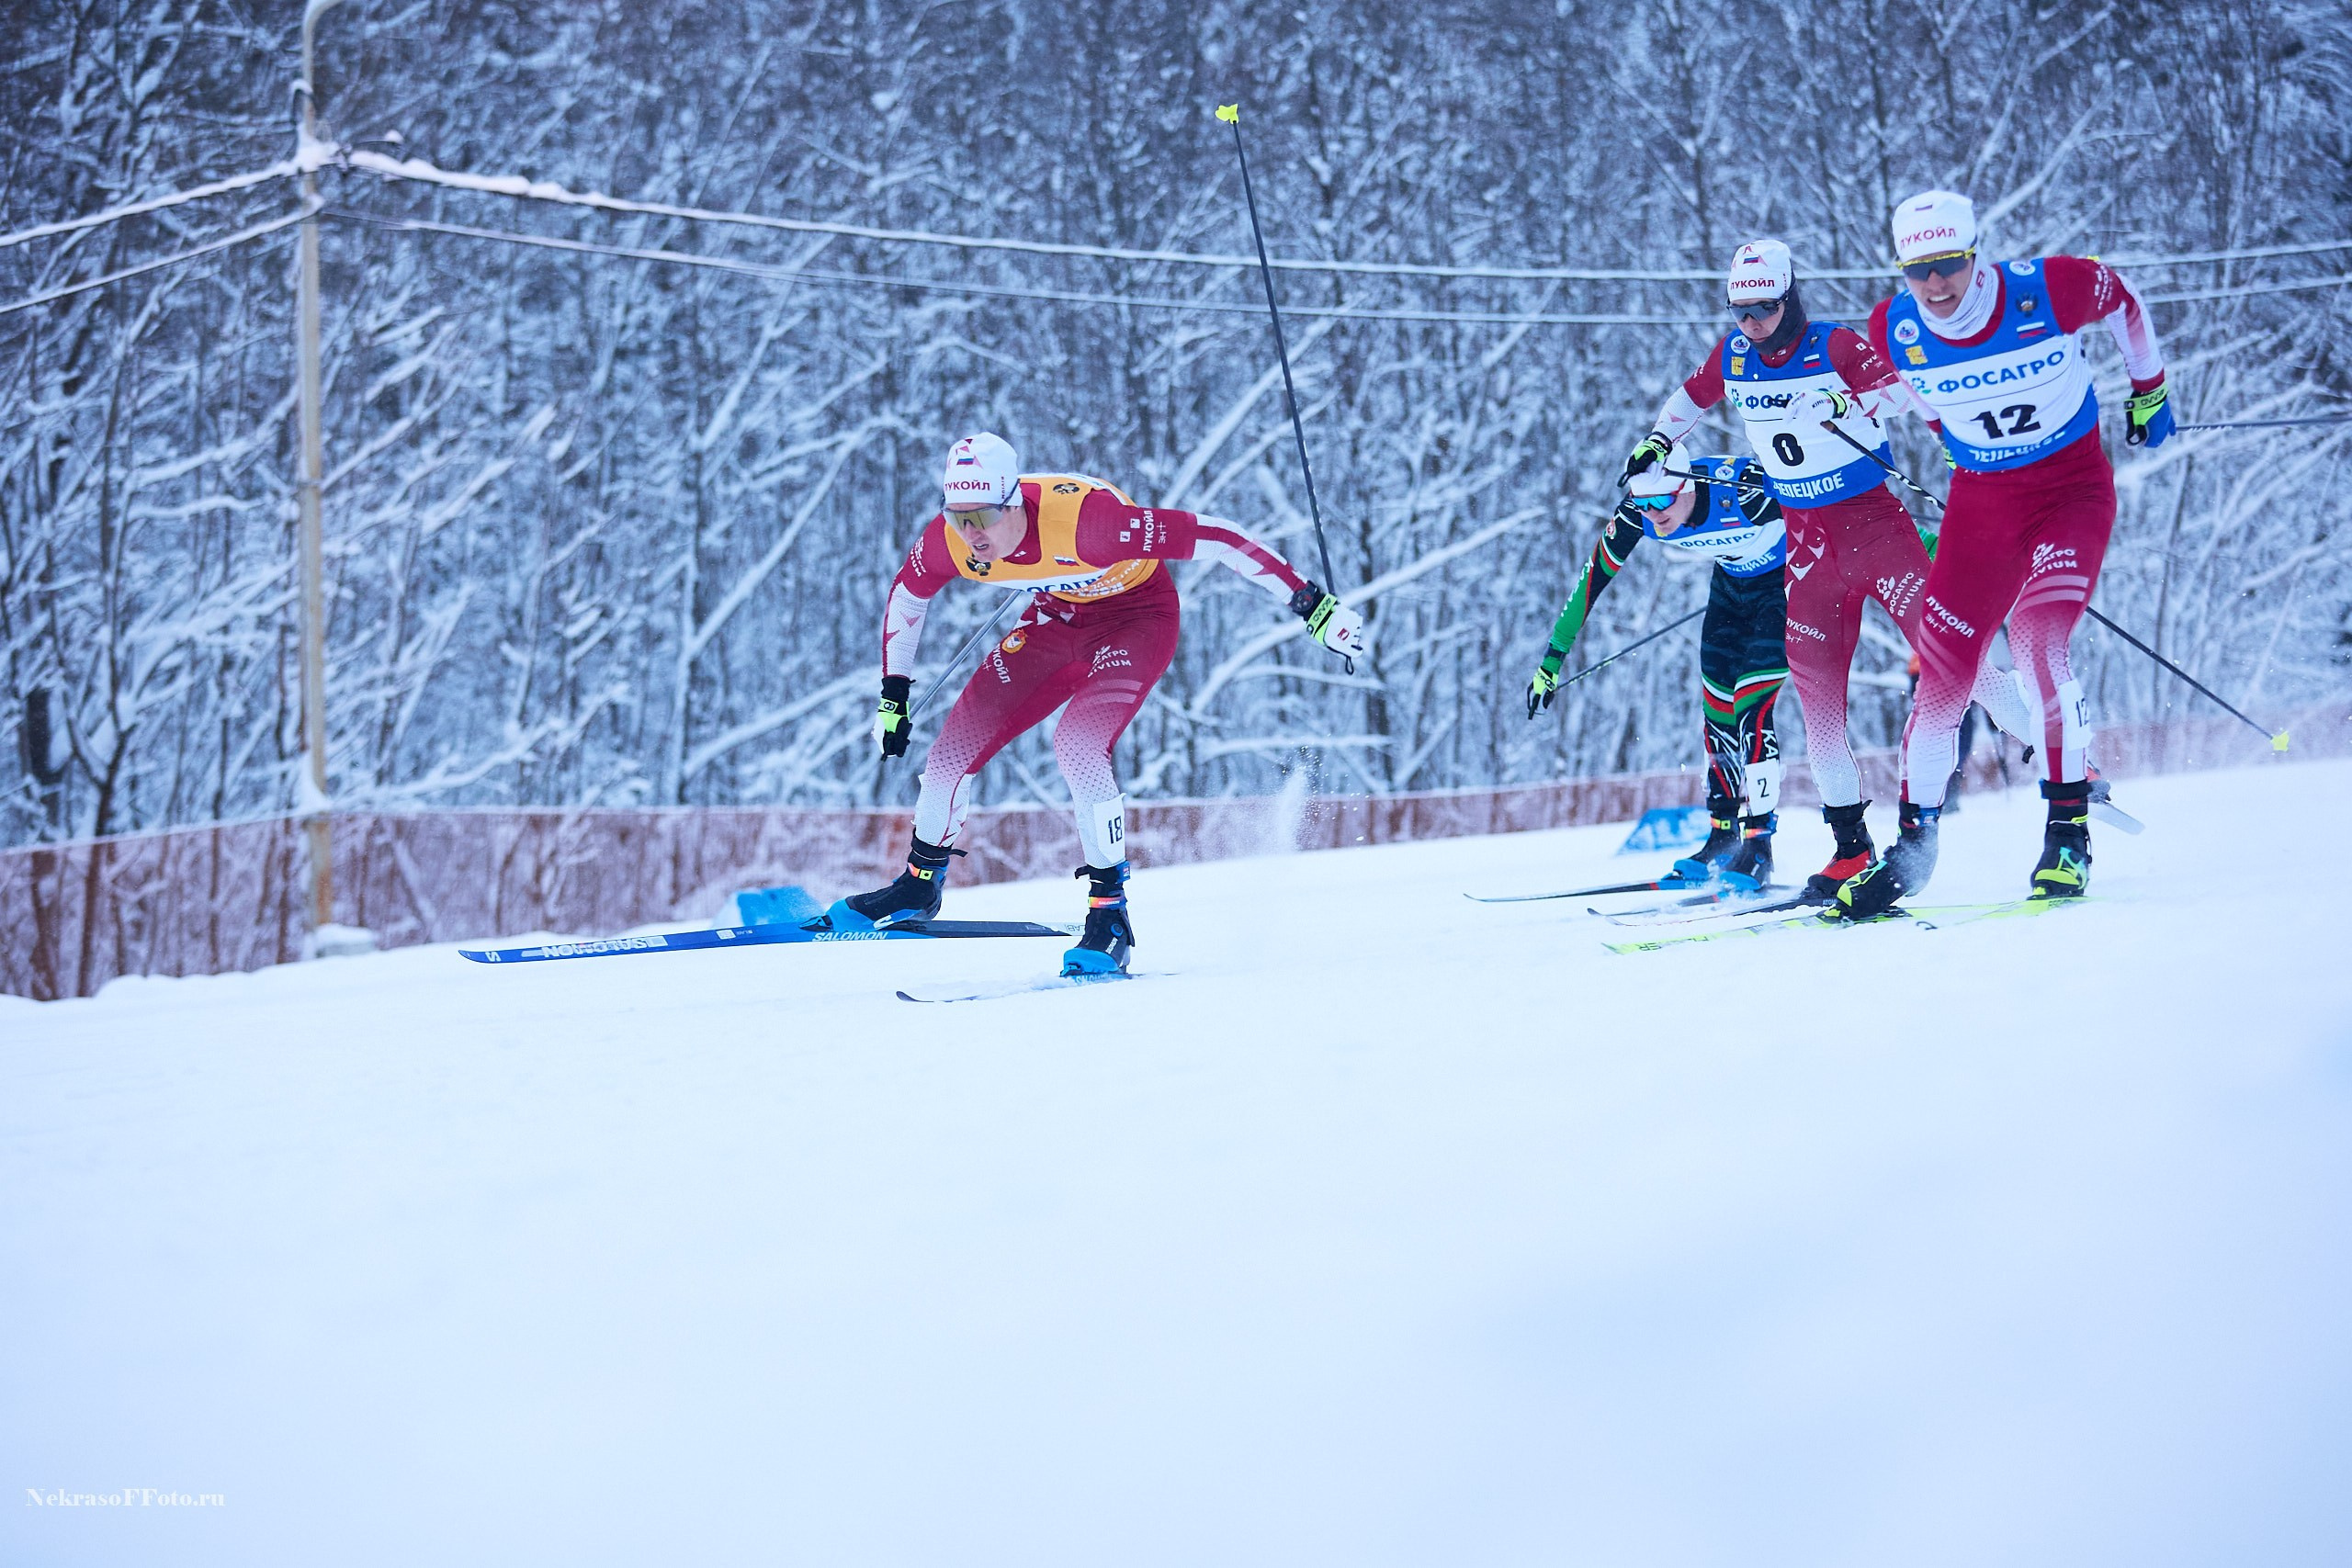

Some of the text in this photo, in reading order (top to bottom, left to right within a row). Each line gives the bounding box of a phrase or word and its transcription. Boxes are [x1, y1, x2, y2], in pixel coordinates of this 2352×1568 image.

[1900, 226, 1956, 250] ЛУКОЙЛ
[1731, 277, 1775, 290] ЛУКОЙЛ
[1938, 351, 2064, 393] ФОСАГРО
[1970, 404, 2041, 439] 12
[1772, 433, 1804, 466] 0
[1142, 510, 1155, 552] ЛУКОЙЛ
[1680, 533, 1755, 547] ФОСАГРО
[1897, 578, 1926, 617] BIVIUM
[1925, 595, 1975, 638] ЛУКОЙЛ
[1758, 778, 1770, 798] 2
[1108, 815, 1123, 844] 18
[812, 931, 888, 942] SALOMON
